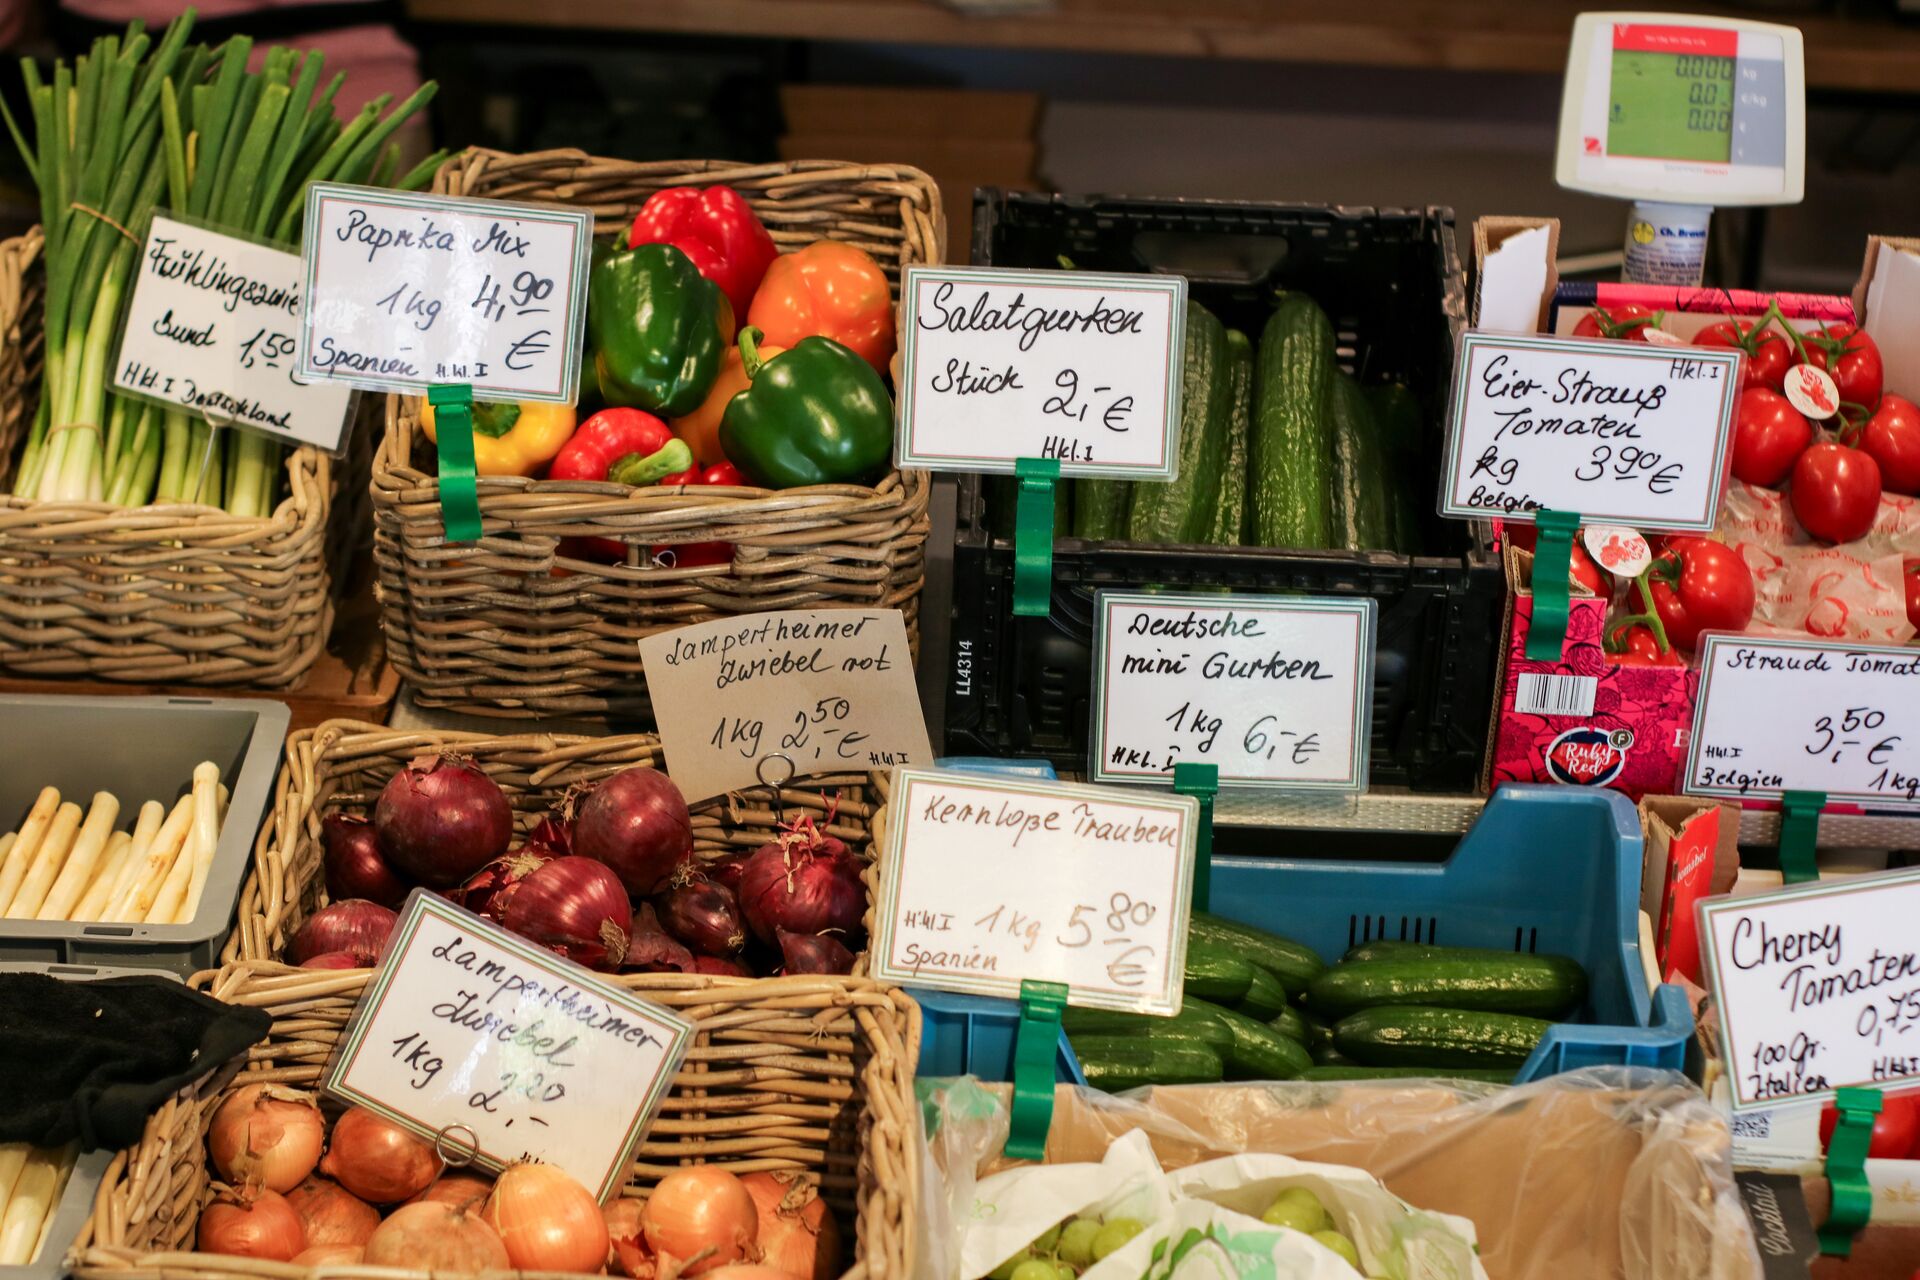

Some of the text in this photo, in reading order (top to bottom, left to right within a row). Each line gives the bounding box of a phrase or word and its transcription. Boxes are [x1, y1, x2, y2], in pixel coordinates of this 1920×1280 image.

[336, 208, 531, 263] Paprika Mix
[153, 309, 217, 347] Bund
[918, 281, 1145, 352] Salatgurken
[312, 337, 420, 379] Spanien
[931, 357, 1025, 396] Stück
[1493, 406, 1643, 441] Tomaten
[1467, 484, 1552, 513] Belgien
[1126, 610, 1267, 640] Deutsche
[841, 643, 893, 673] rot
[955, 639, 973, 696] LL4314
[1121, 648, 1335, 681] mini Gurken
[1565, 741, 1615, 765] Ruby
[1567, 758, 1604, 776] Red
[1699, 766, 1784, 795] Belgien
[1071, 802, 1178, 848] Trauben
[900, 943, 998, 978] Spanien
[1779, 947, 1920, 1013] Tomaten
[1748, 1071, 1831, 1101] Italien
